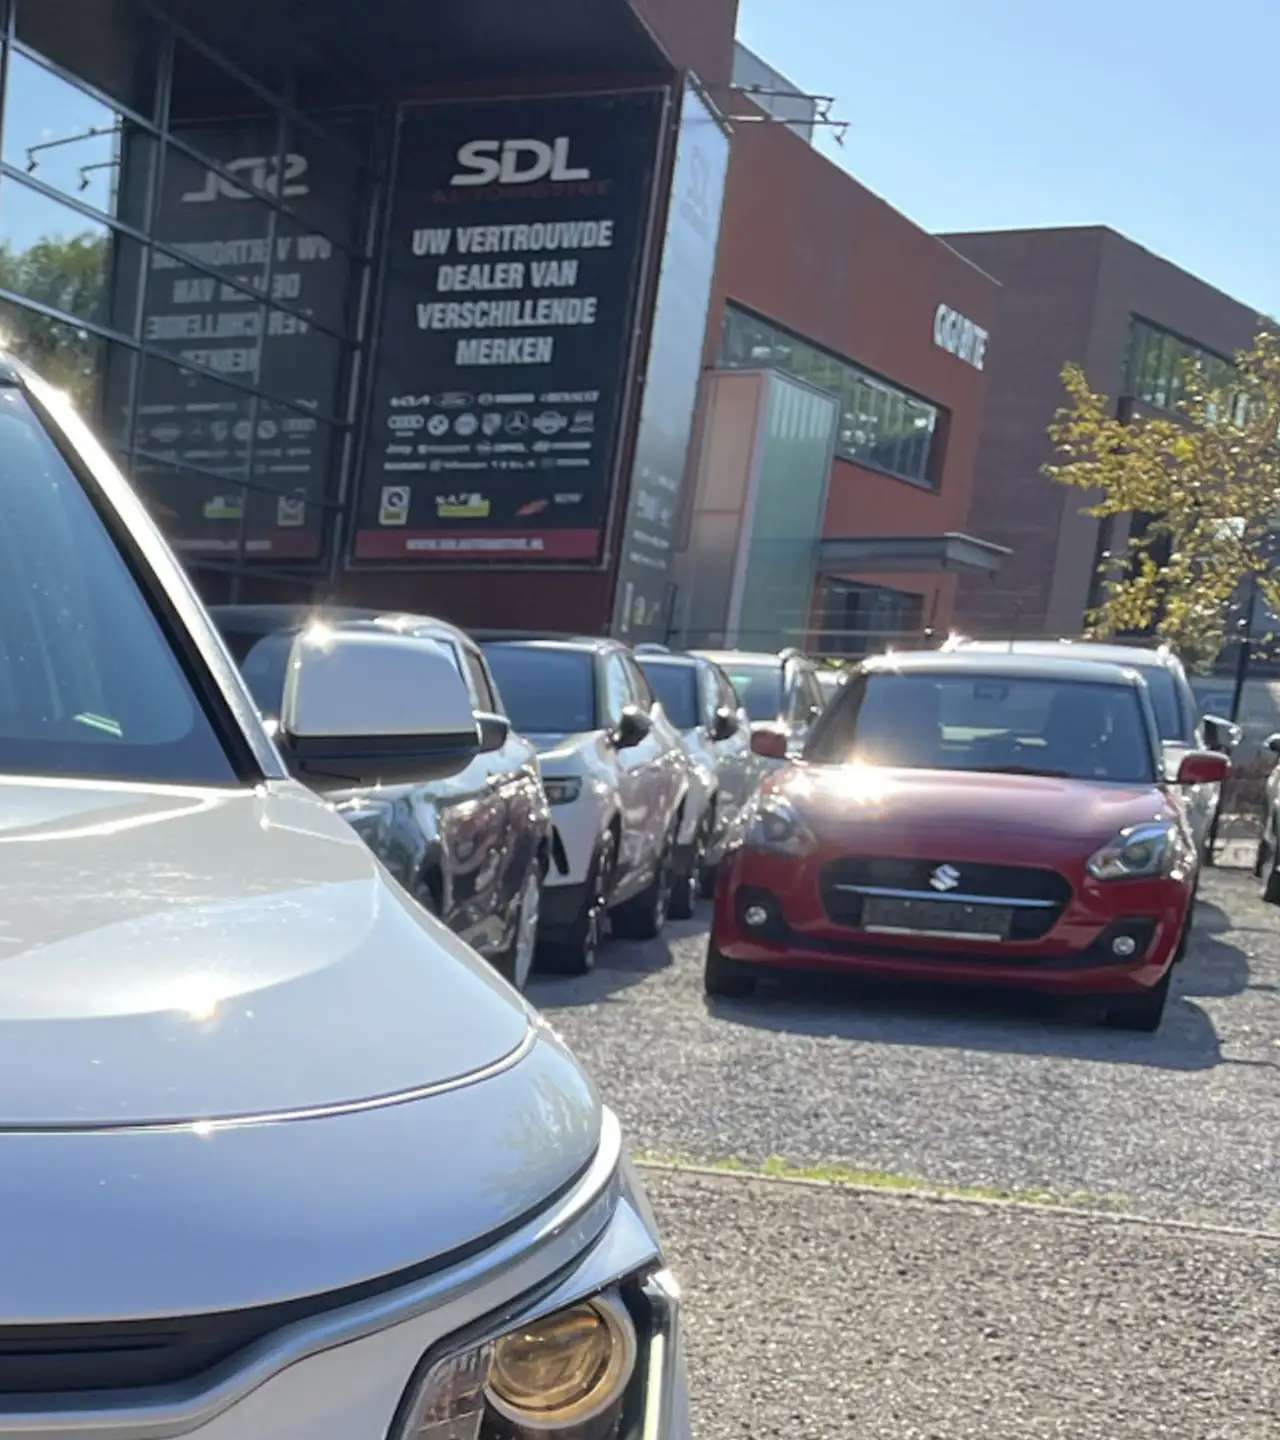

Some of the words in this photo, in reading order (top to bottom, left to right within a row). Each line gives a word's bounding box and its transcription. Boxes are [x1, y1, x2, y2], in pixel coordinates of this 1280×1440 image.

[450, 137, 590, 185] SDL
[412, 228, 451, 255] UW
[456, 220, 614, 254] VERTROUWDE
[436, 262, 525, 292] DEALER
[531, 260, 578, 288] VAN
[416, 296, 598, 330] VERSCHILLENDE
[456, 336, 554, 365] MERKEN
